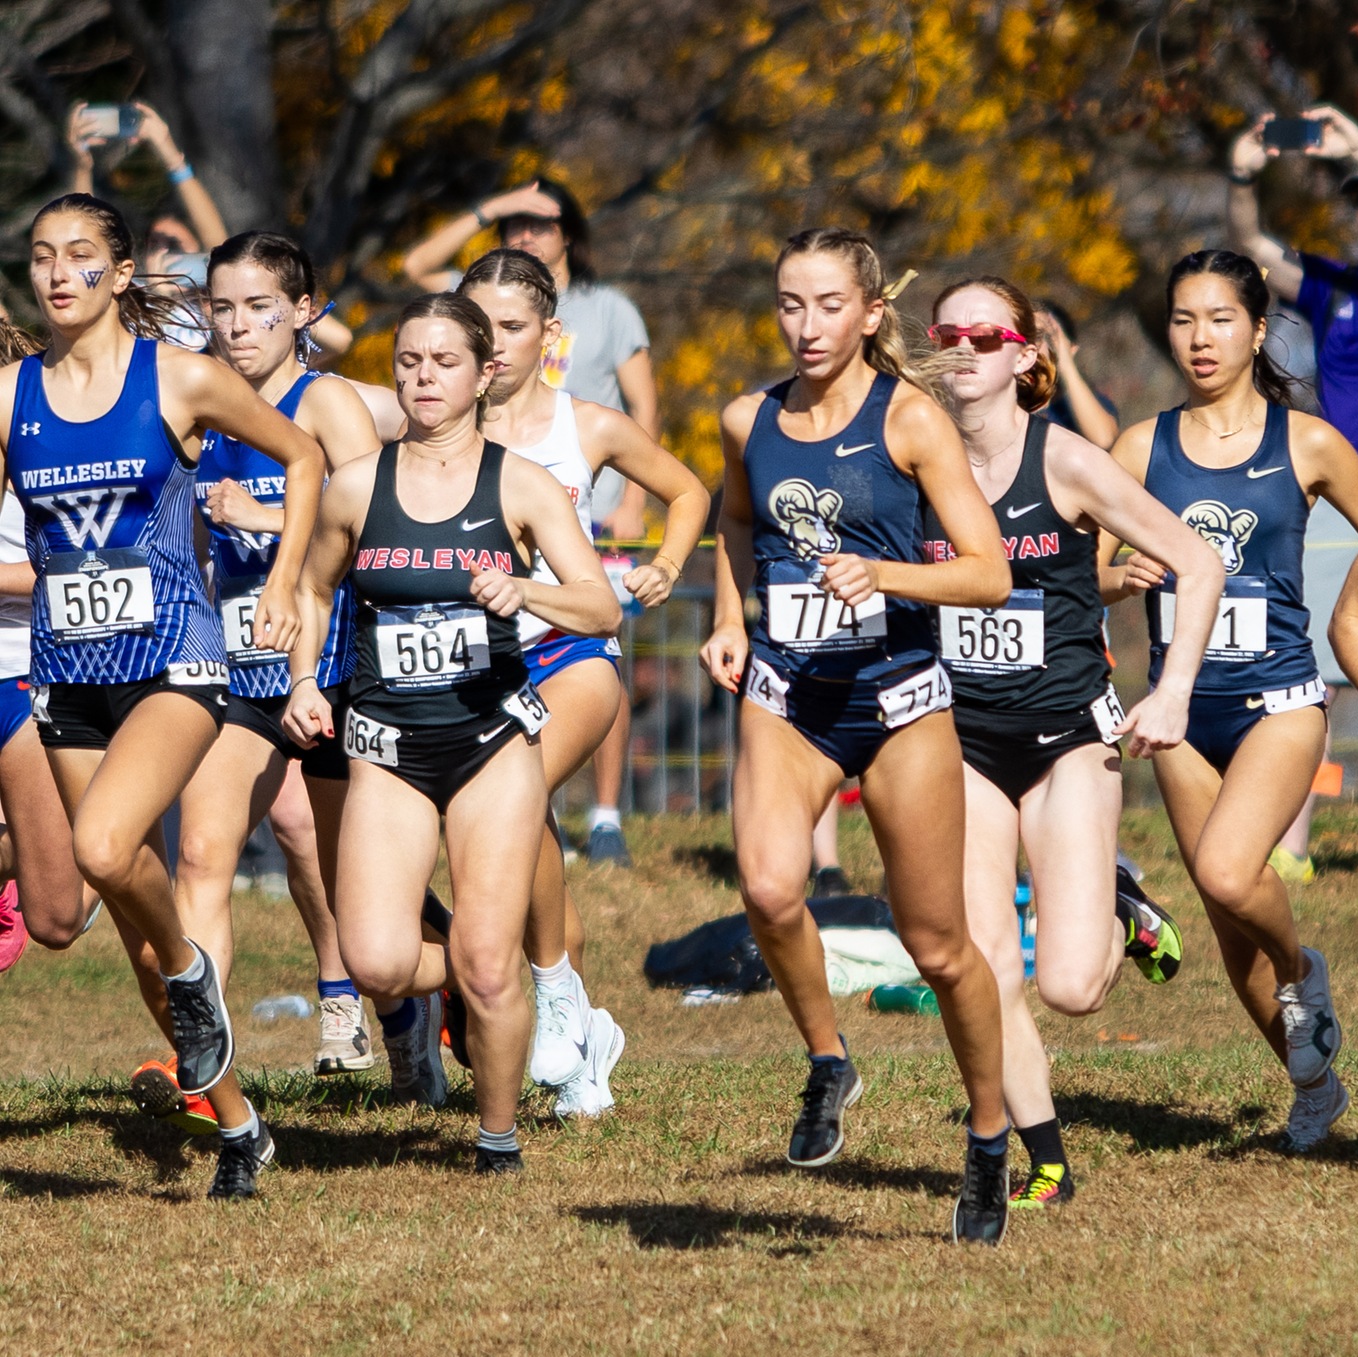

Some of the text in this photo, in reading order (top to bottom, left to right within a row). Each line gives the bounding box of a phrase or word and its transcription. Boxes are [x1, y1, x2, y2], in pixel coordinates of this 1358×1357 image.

[22, 459, 147, 490] WELLESLEY
[356, 548, 514, 574] WESLEYAN
[63, 577, 135, 627] 562
[791, 592, 863, 639] 774
[396, 627, 474, 676] 564
[958, 615, 1024, 663] 563
[749, 665, 772, 702] 74
[899, 672, 949, 714] 774
[346, 714, 385, 759] 564
